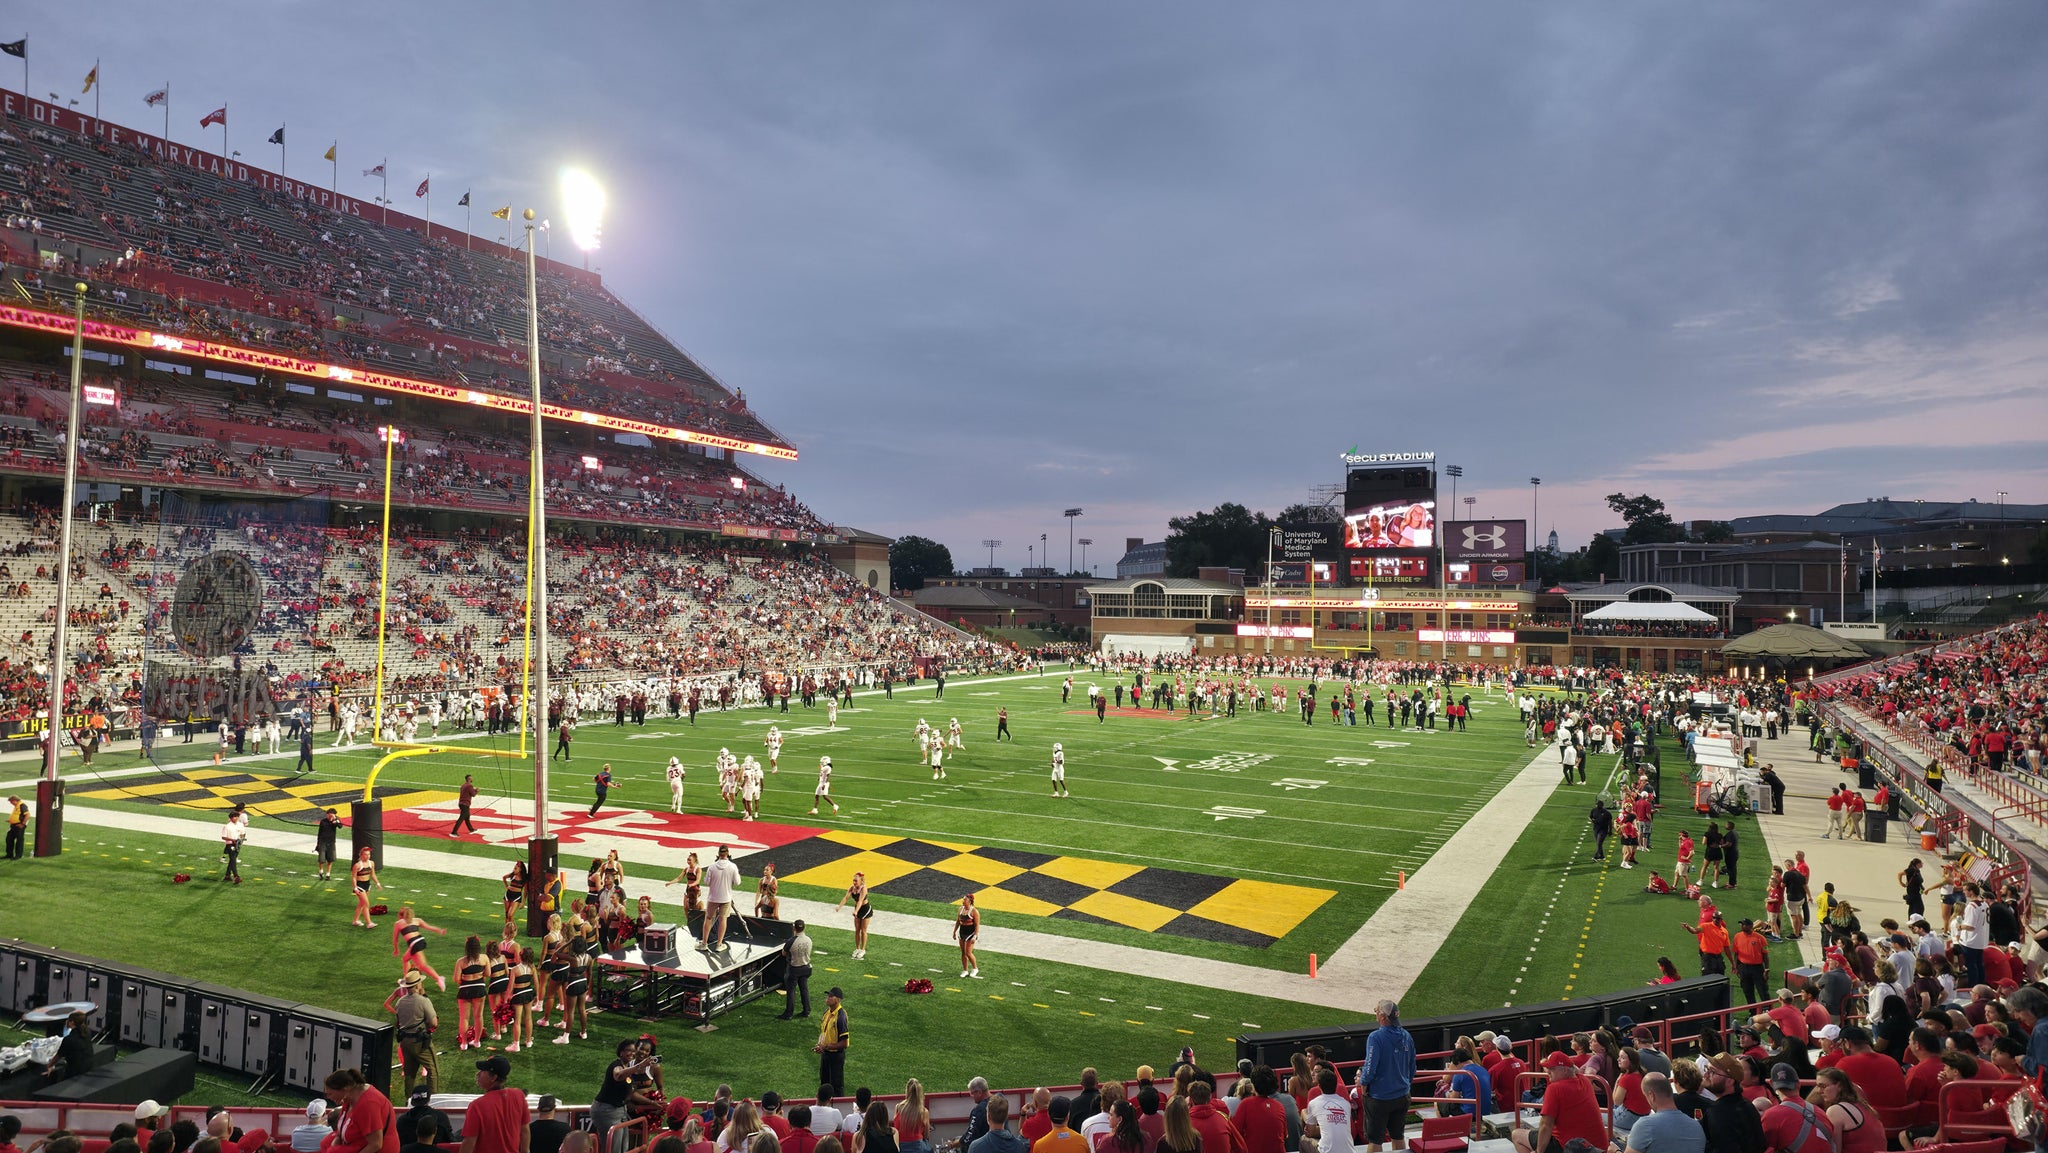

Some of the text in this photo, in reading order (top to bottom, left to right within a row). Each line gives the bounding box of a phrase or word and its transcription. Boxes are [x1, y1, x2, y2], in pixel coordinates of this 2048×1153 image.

[33, 103, 60, 125] OF
[78, 117, 120, 144] THE
[137, 135, 248, 182] MARYLAND
[261, 174, 360, 216] TERRAPINS
[1346, 451, 1435, 463] secu STADIUM
[1285, 531, 1322, 539] University
[1376, 558, 1400, 567] 29:47
[1323, 571, 1330, 580] 0
[1456, 572, 1462, 580] 0
[386, 694, 403, 704] GOT
[22, 716, 49, 733] THE
[668, 768, 680, 779] 23
[579, 1117, 593, 1132] 17
